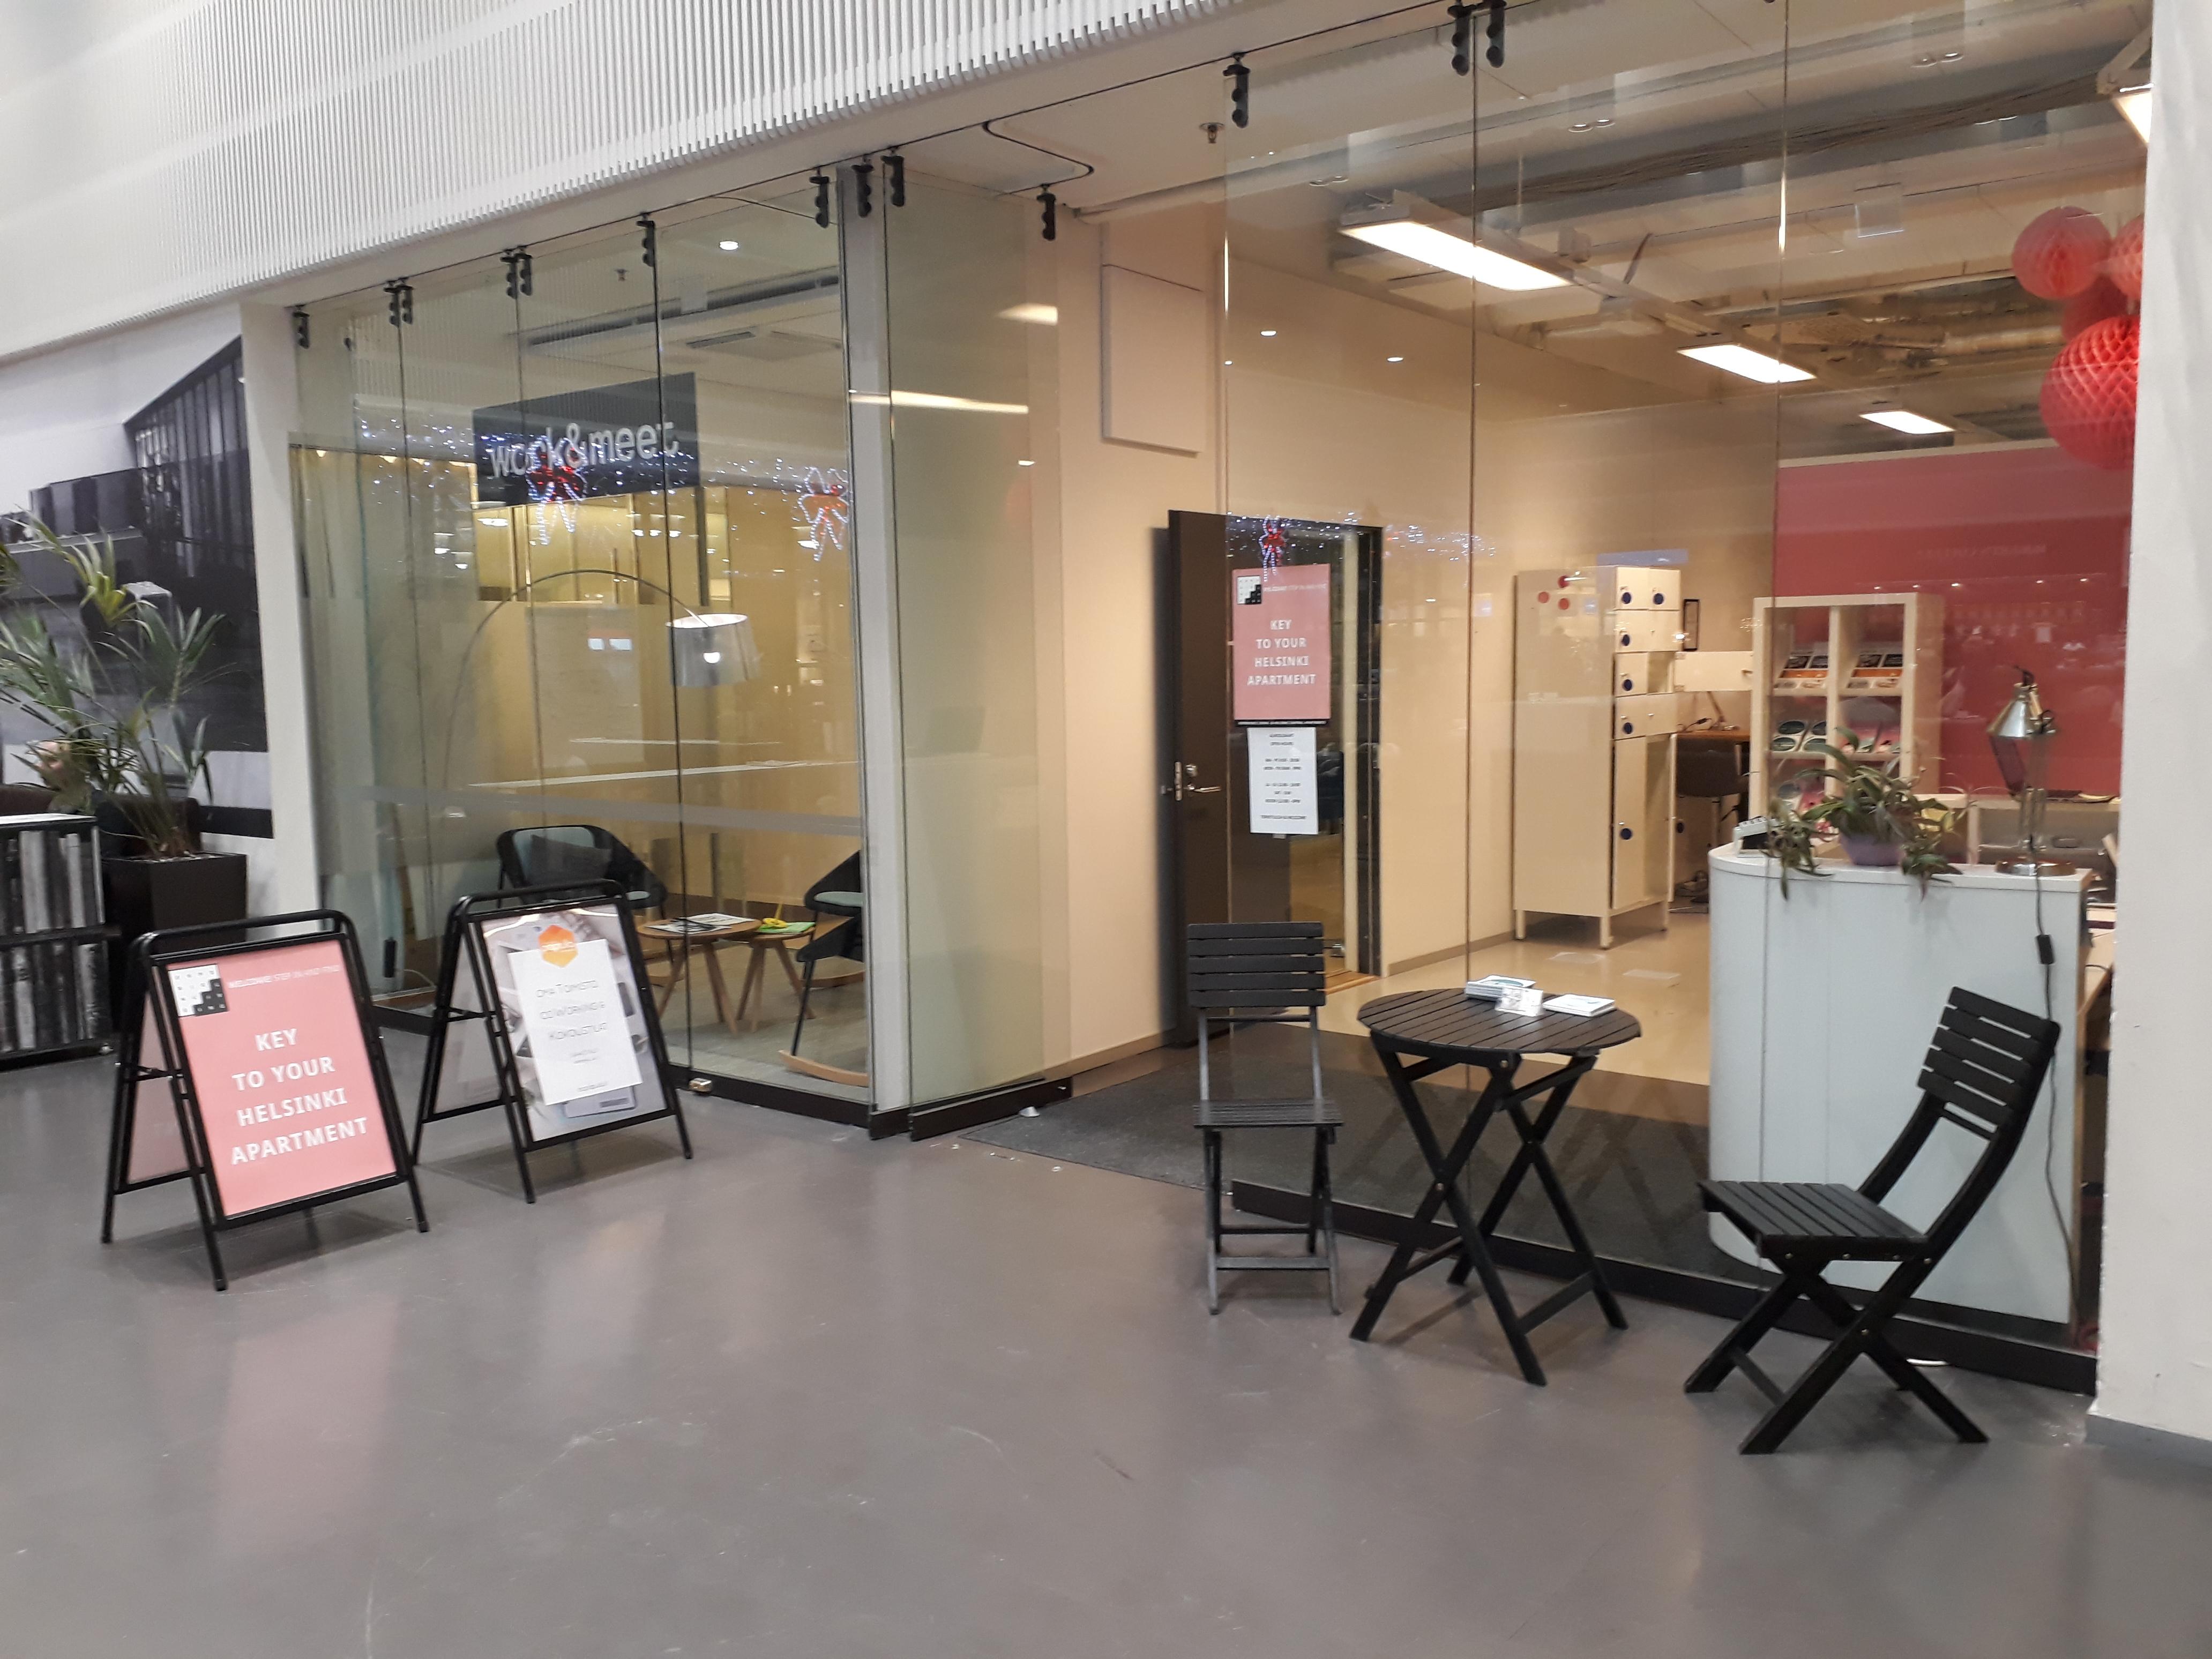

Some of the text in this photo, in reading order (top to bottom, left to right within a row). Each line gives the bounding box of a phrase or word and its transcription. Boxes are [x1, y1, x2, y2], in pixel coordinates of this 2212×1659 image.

[1269, 619, 1292, 630] KEY
[1256, 637, 1306, 649] TO YOUR
[1254, 655, 1309, 667] HELSINKI
[1247, 674, 1316, 686] APARTMENT
[255, 1028, 297, 1052] KEY
[231, 1056, 335, 1091] TO YOUR
[237, 1088, 348, 1127] HELSINKI
[231, 1117, 368, 1165] APARTMENT
